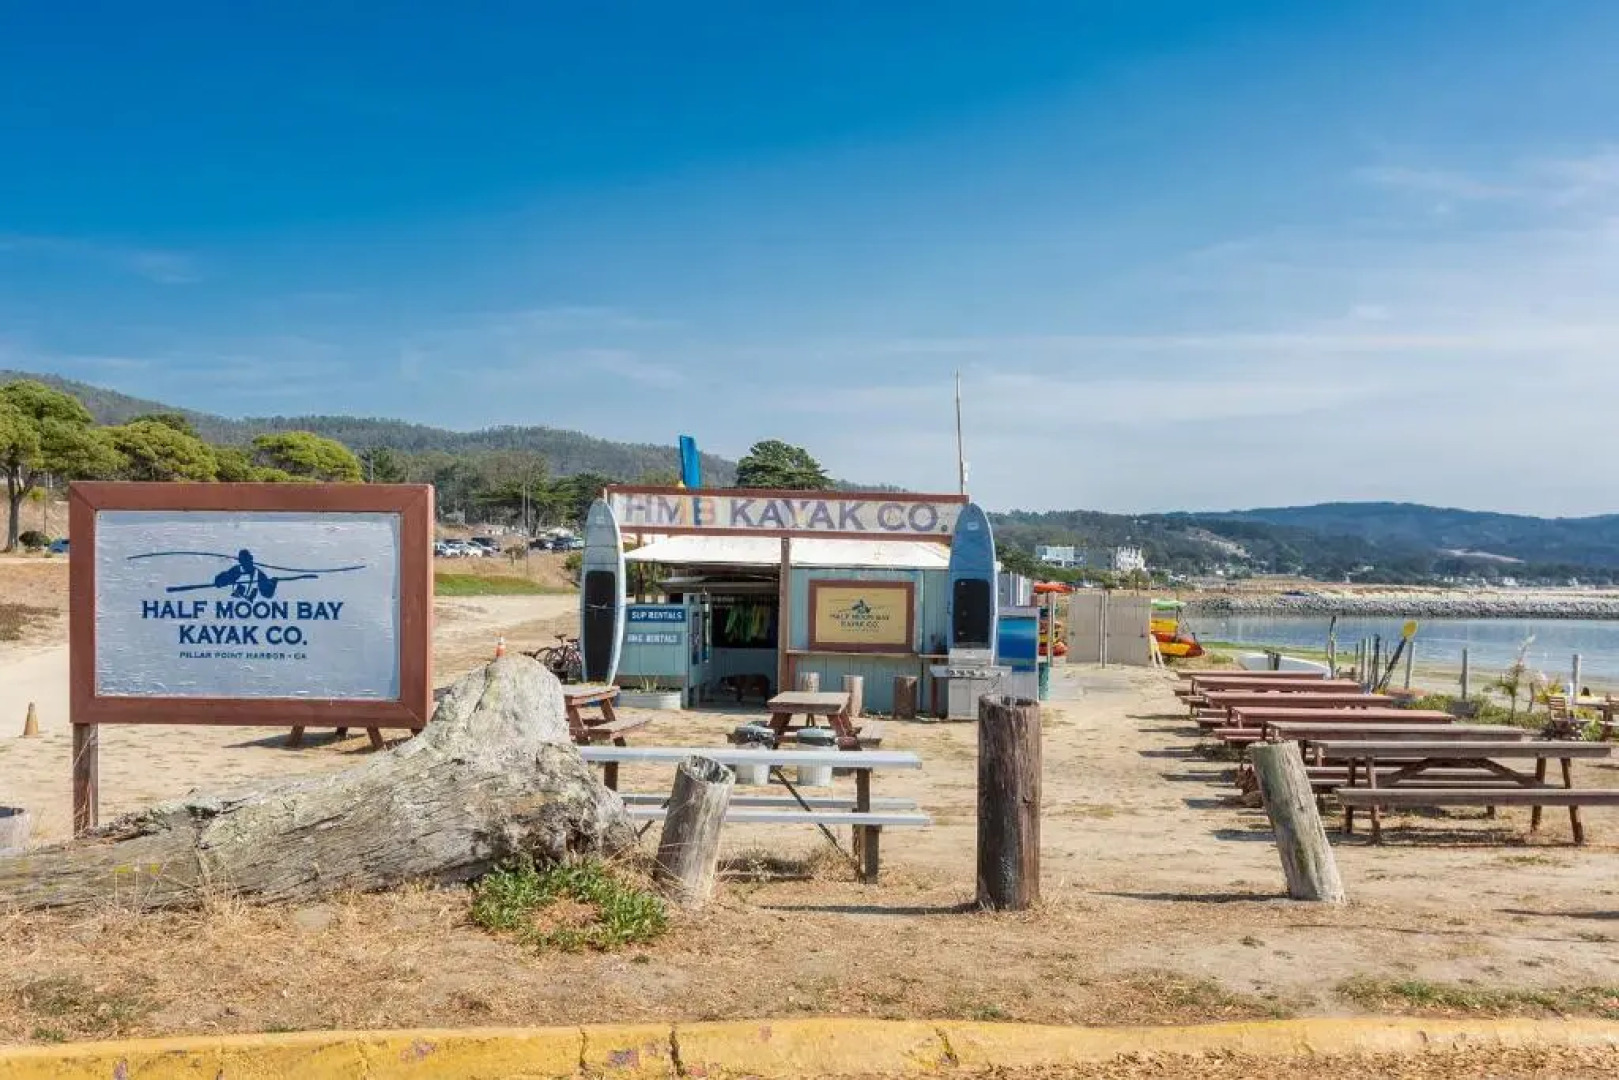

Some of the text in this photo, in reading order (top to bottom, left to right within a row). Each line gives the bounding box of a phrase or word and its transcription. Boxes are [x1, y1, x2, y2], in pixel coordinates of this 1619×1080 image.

[625, 495, 948, 533] HMB KAYAK CO.
[142, 600, 344, 621] HALF MOON BAY
[631, 611, 683, 620] SUP RENTALS
[178, 624, 308, 646] KAYAK CO.
[179, 651, 307, 660] PILLAR POINT HARBOR CA
